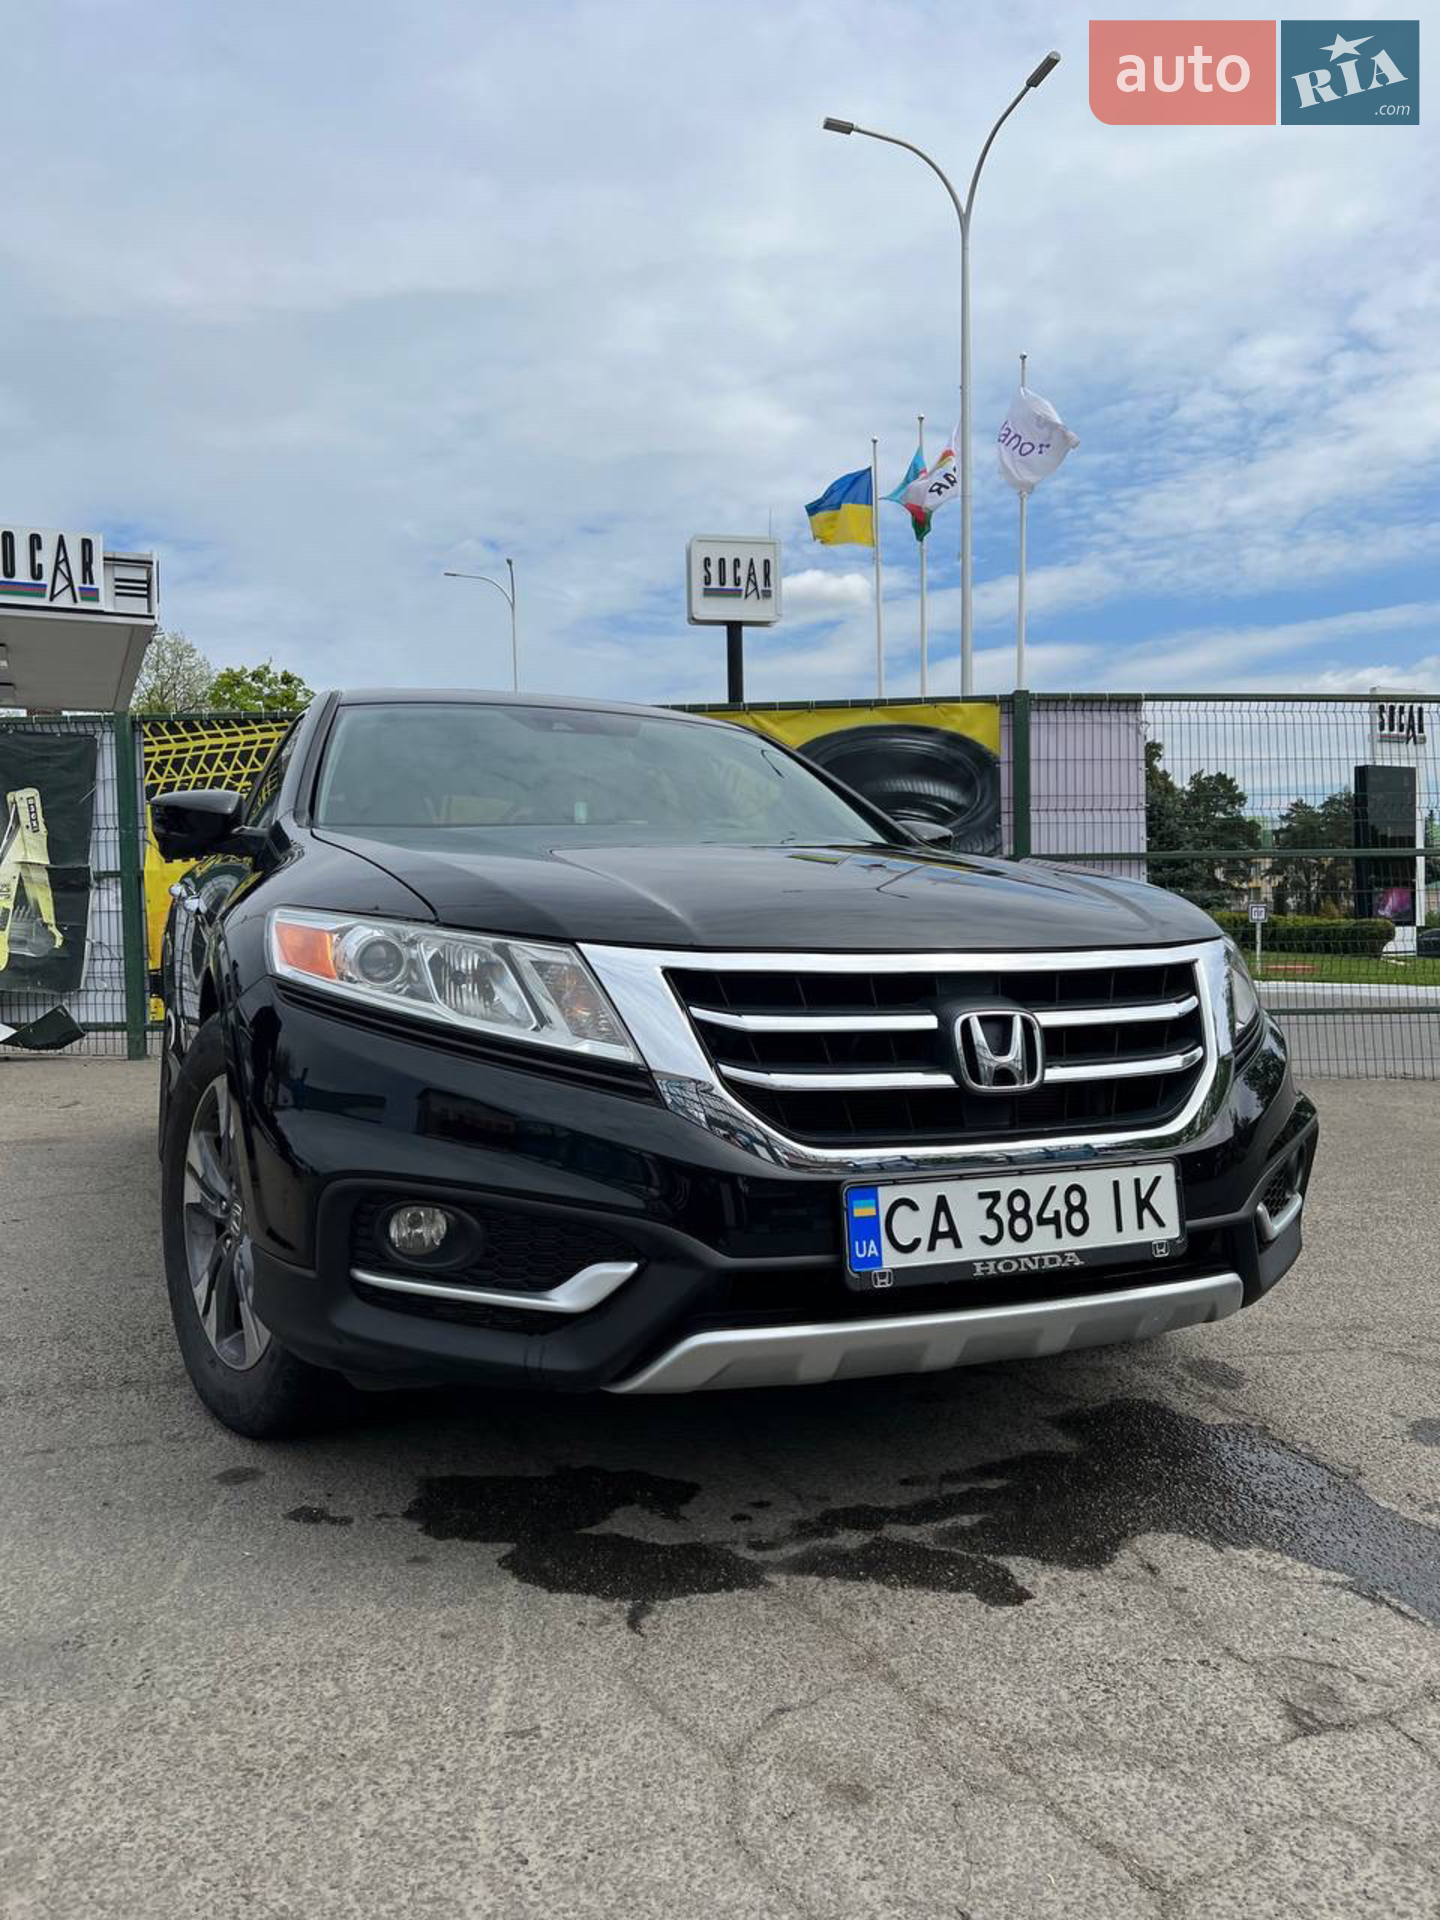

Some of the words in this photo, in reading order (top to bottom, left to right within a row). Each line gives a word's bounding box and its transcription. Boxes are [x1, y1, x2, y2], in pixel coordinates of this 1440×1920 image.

[1, 530, 95, 603] OCAR
[703, 556, 771, 600] SOCAR
[884, 1194, 963, 1254] CA
[978, 1184, 1090, 1246] 3848
[1112, 1175, 1167, 1234] IK
[855, 1241, 879, 1259] UA
[972, 1252, 1085, 1278] HONDA
